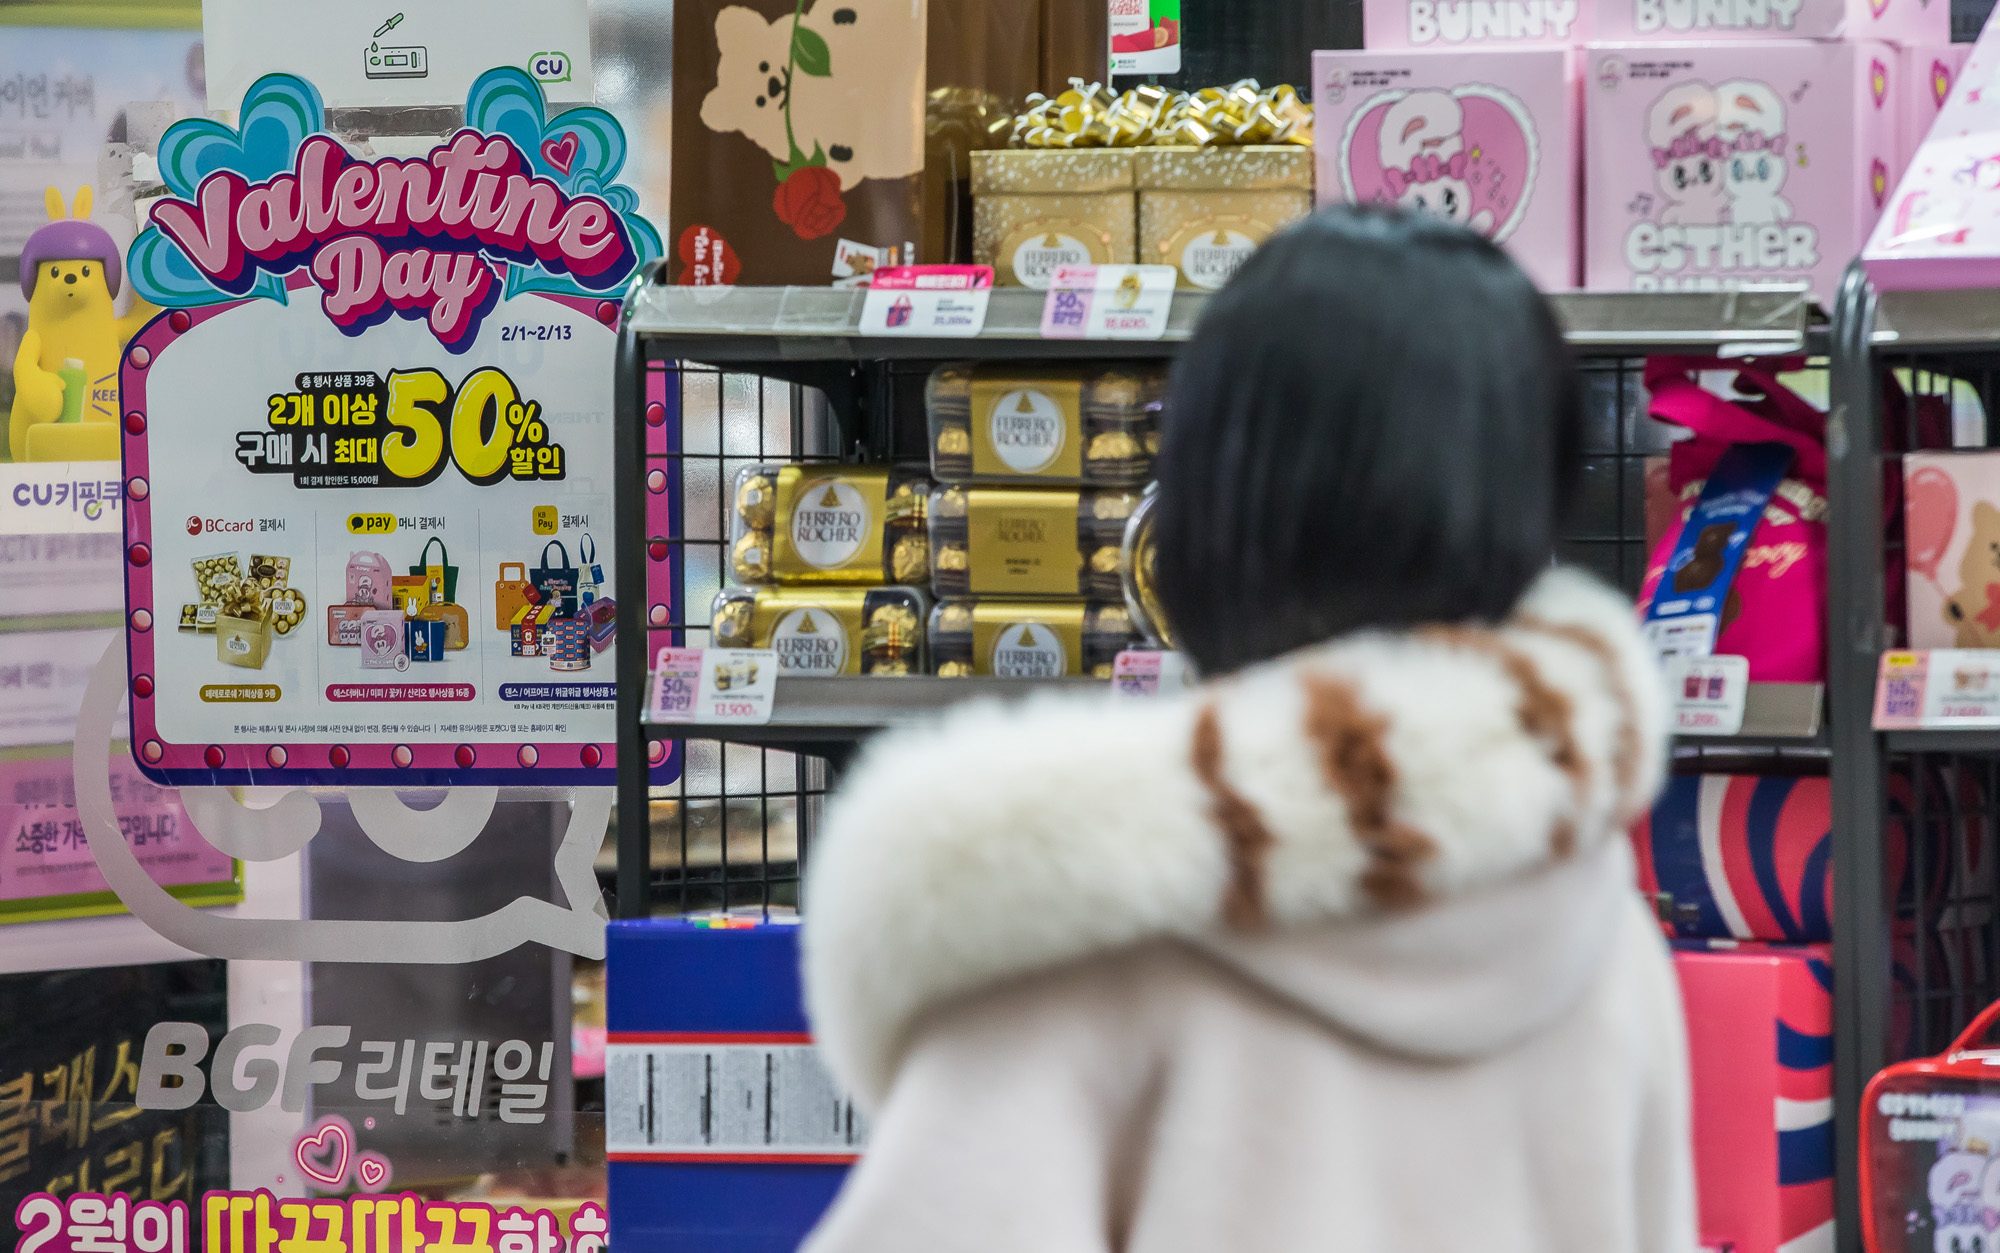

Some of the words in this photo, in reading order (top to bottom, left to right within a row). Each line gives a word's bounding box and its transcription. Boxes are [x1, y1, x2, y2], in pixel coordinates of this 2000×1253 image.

[536, 60, 562, 75] CU
[152, 132, 622, 279] Valentine
[312, 234, 484, 336] Day
[501, 325, 572, 341] 2/1~2/13
[301, 375, 311, 388] 총
[313, 375, 331, 388] 행사
[334, 375, 352, 387] 상품
[354, 374, 375, 387] 39종
[93, 389, 119, 402] KEE
[269, 393, 315, 426] 2개
[322, 393, 379, 426] 이상
[237, 432, 293, 466] 구매
[300, 432, 328, 465] 시
[334, 437, 378, 464] 최대
[509, 446, 561, 475] 할인
[258, 518, 286, 532] 결제시
[366, 516, 391, 531] pay
[398, 517, 417, 530] 머니
[418, 517, 446, 530] 결제시
[538, 518, 553, 530] Pay
[561, 514, 589, 528] 결제시
[799, 511, 861, 527] FERRERO
[797, 526, 859, 543] ROCHER
[776, 637, 838, 652] FERRERO
[16, 821, 59, 855] 소중한
